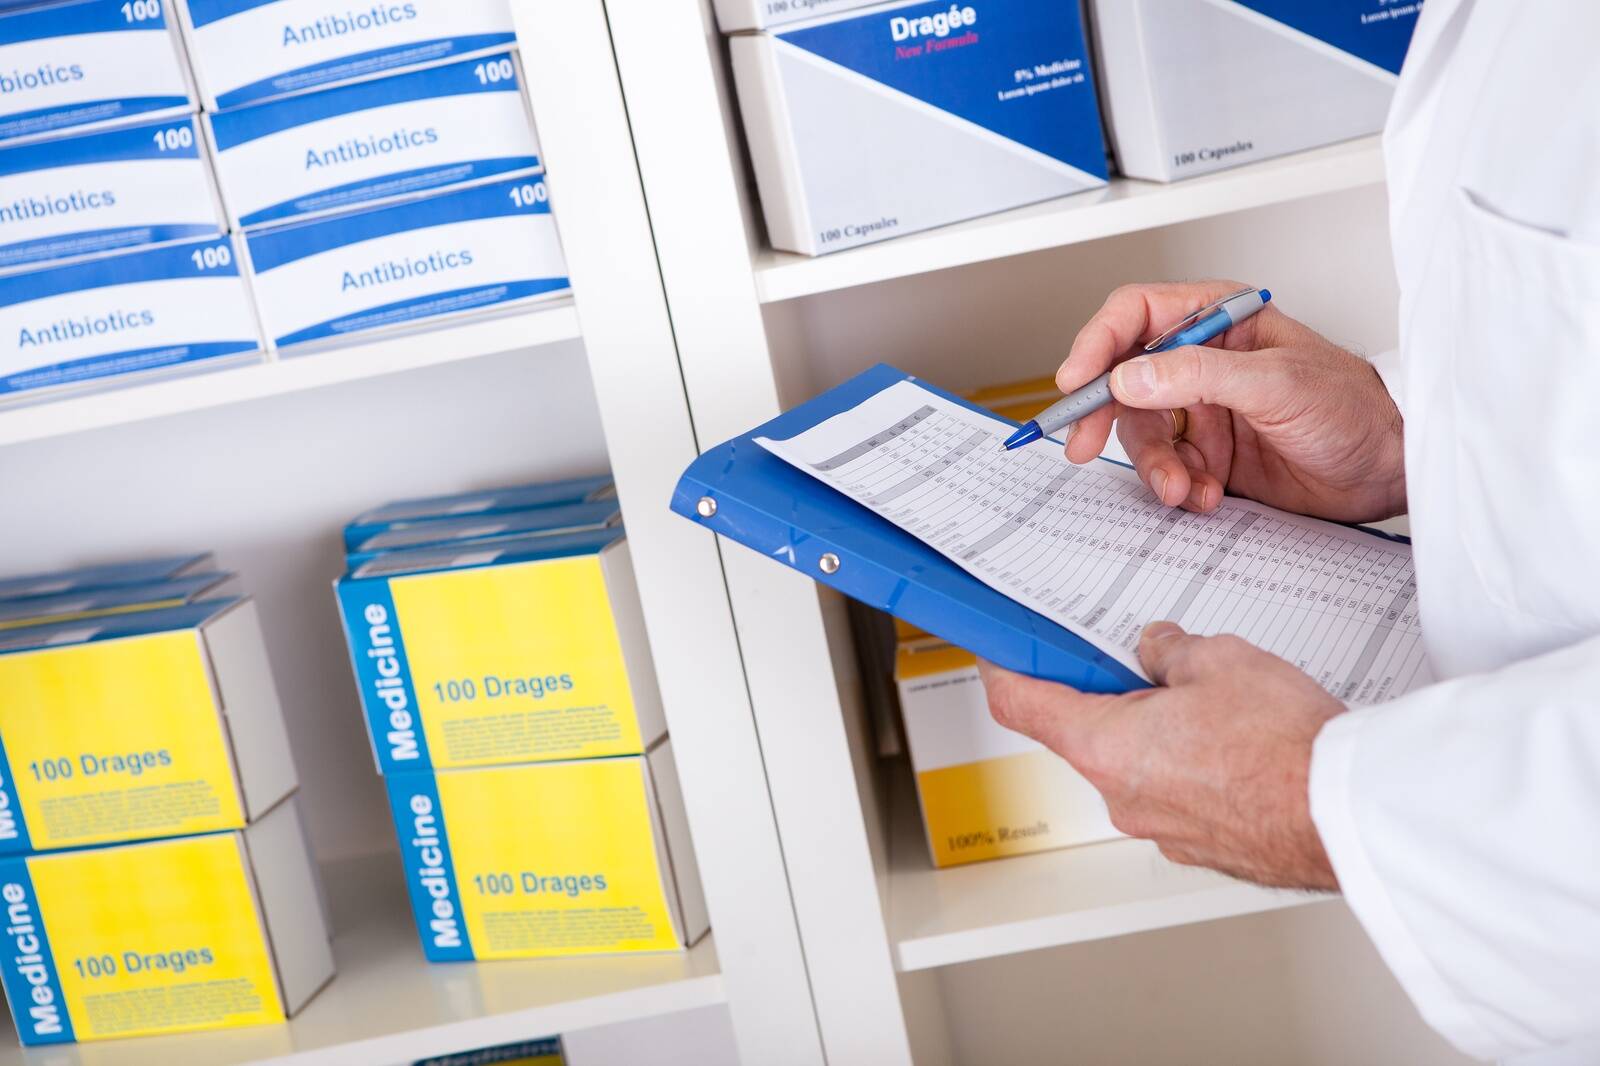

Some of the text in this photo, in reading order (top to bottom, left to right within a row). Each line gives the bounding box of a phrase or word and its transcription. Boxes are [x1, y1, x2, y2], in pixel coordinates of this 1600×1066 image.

[121, 0, 161, 23] 100
[281, 1, 418, 47] Antibiotics
[889, 4, 978, 42] Dragée
[895, 31, 978, 61] New Formula
[474, 57, 514, 84] 100
[1034, 59, 1081, 77] Medicine
[153, 125, 193, 151] 100
[304, 124, 439, 170] Antibiotics
[1174, 139, 1253, 167] 100 Capsules
[508, 181, 547, 208] 100
[820, 216, 899, 244] 100 Capsules
[191, 244, 231, 270] 100
[340, 246, 474, 291] Antibiotics
[18, 307, 155, 348] Antibiotics
[363, 602, 421, 762] Medicine
[433, 672, 574, 703] 100 Drages
[29, 748, 173, 783] 100 Drages
[947, 820, 1051, 853] 100% Result
[409, 793, 463, 949] Medicine
[473, 871, 608, 897] 100 Drages
[1, 881, 64, 1036] Medicine
[73, 946, 214, 979] 100 Drages
